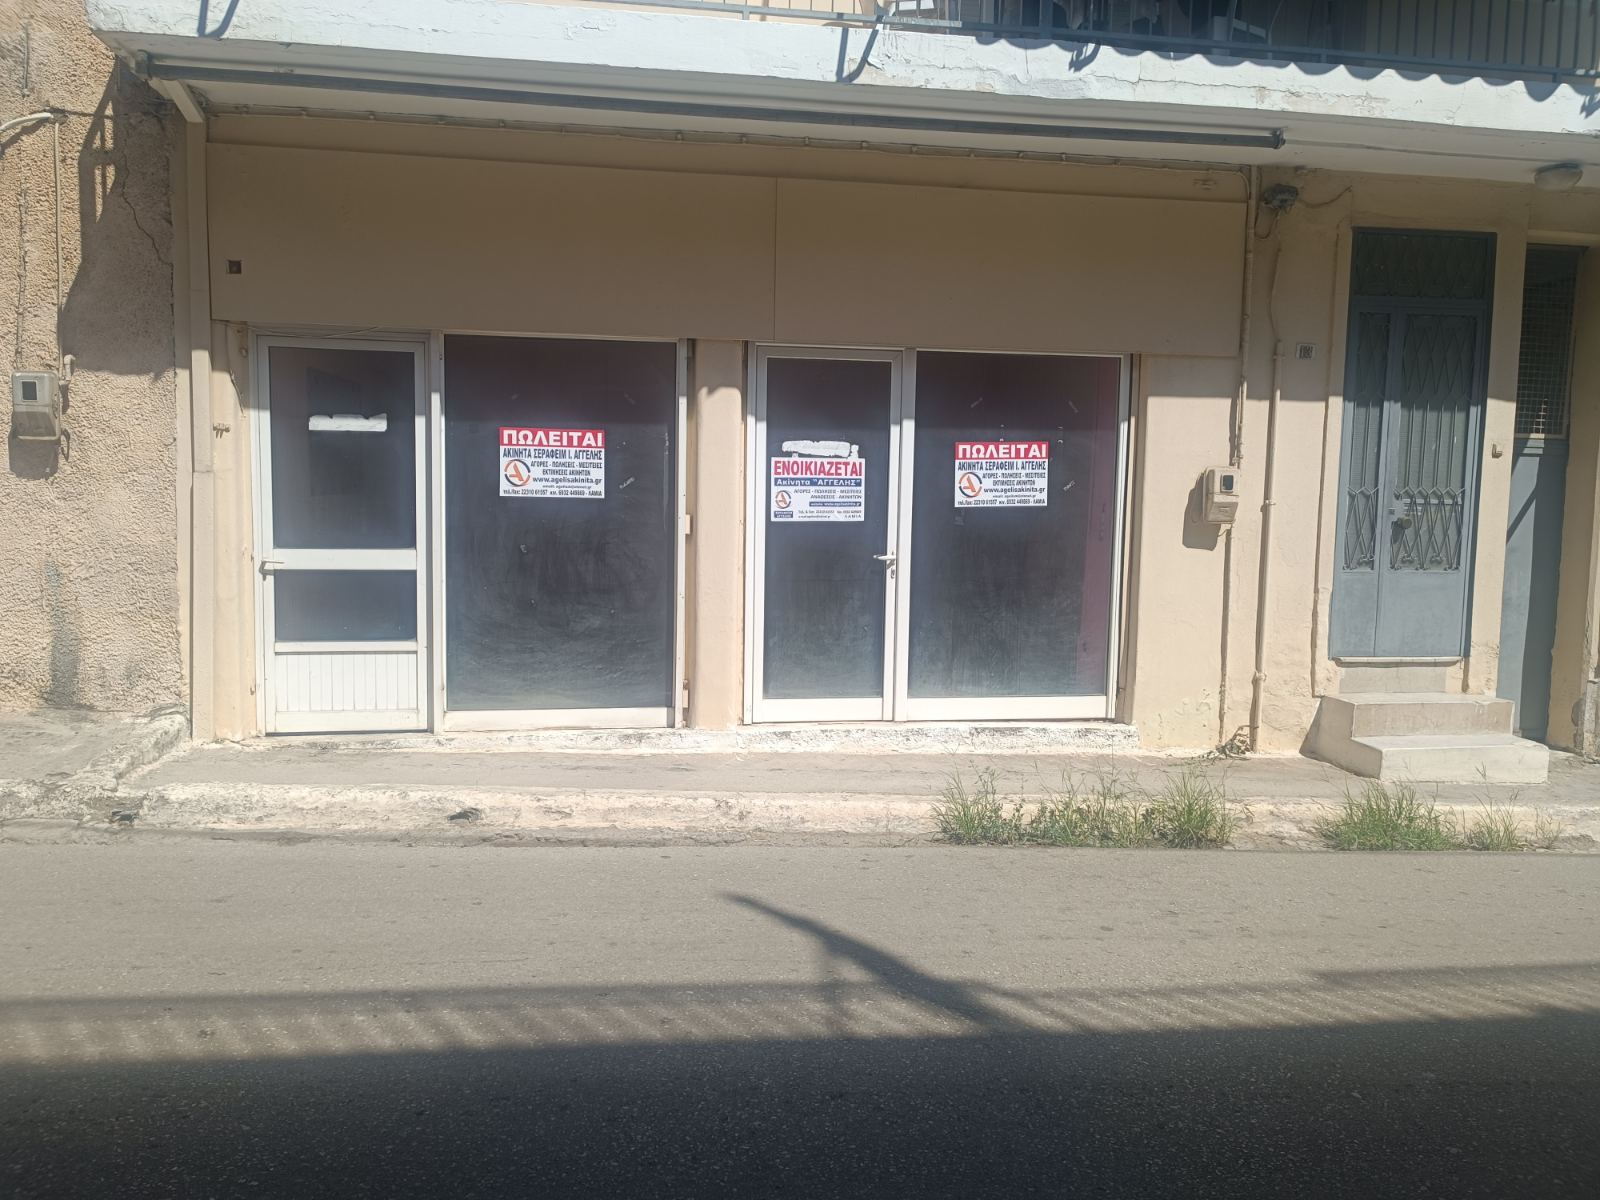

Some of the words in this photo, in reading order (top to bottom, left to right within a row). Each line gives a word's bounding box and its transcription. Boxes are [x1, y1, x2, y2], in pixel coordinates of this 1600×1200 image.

[503, 430, 602, 447] ΠΩΛΕΙΤΑΙ
[503, 448, 531, 458] ΑΚΙΝΗΤΑ
[534, 449, 566, 459] ΣΕΡΑΦΕΙΜ
[574, 450, 602, 460] ΑΓΓΕΛΗΣ
[959, 444, 1046, 458] ΠΩΛΕΙΤΑΙ
[774, 461, 862, 476] ΕΝΟΙΚΙΑΖΕΤΑΙ
[958, 461, 983, 470] ΑΚΙΝΗΤΑ
[985, 461, 1015, 470] ΣΕΡΑΦΕΙΜ
[1021, 461, 1046, 470] ΑΓΓΕΛΗΣ
